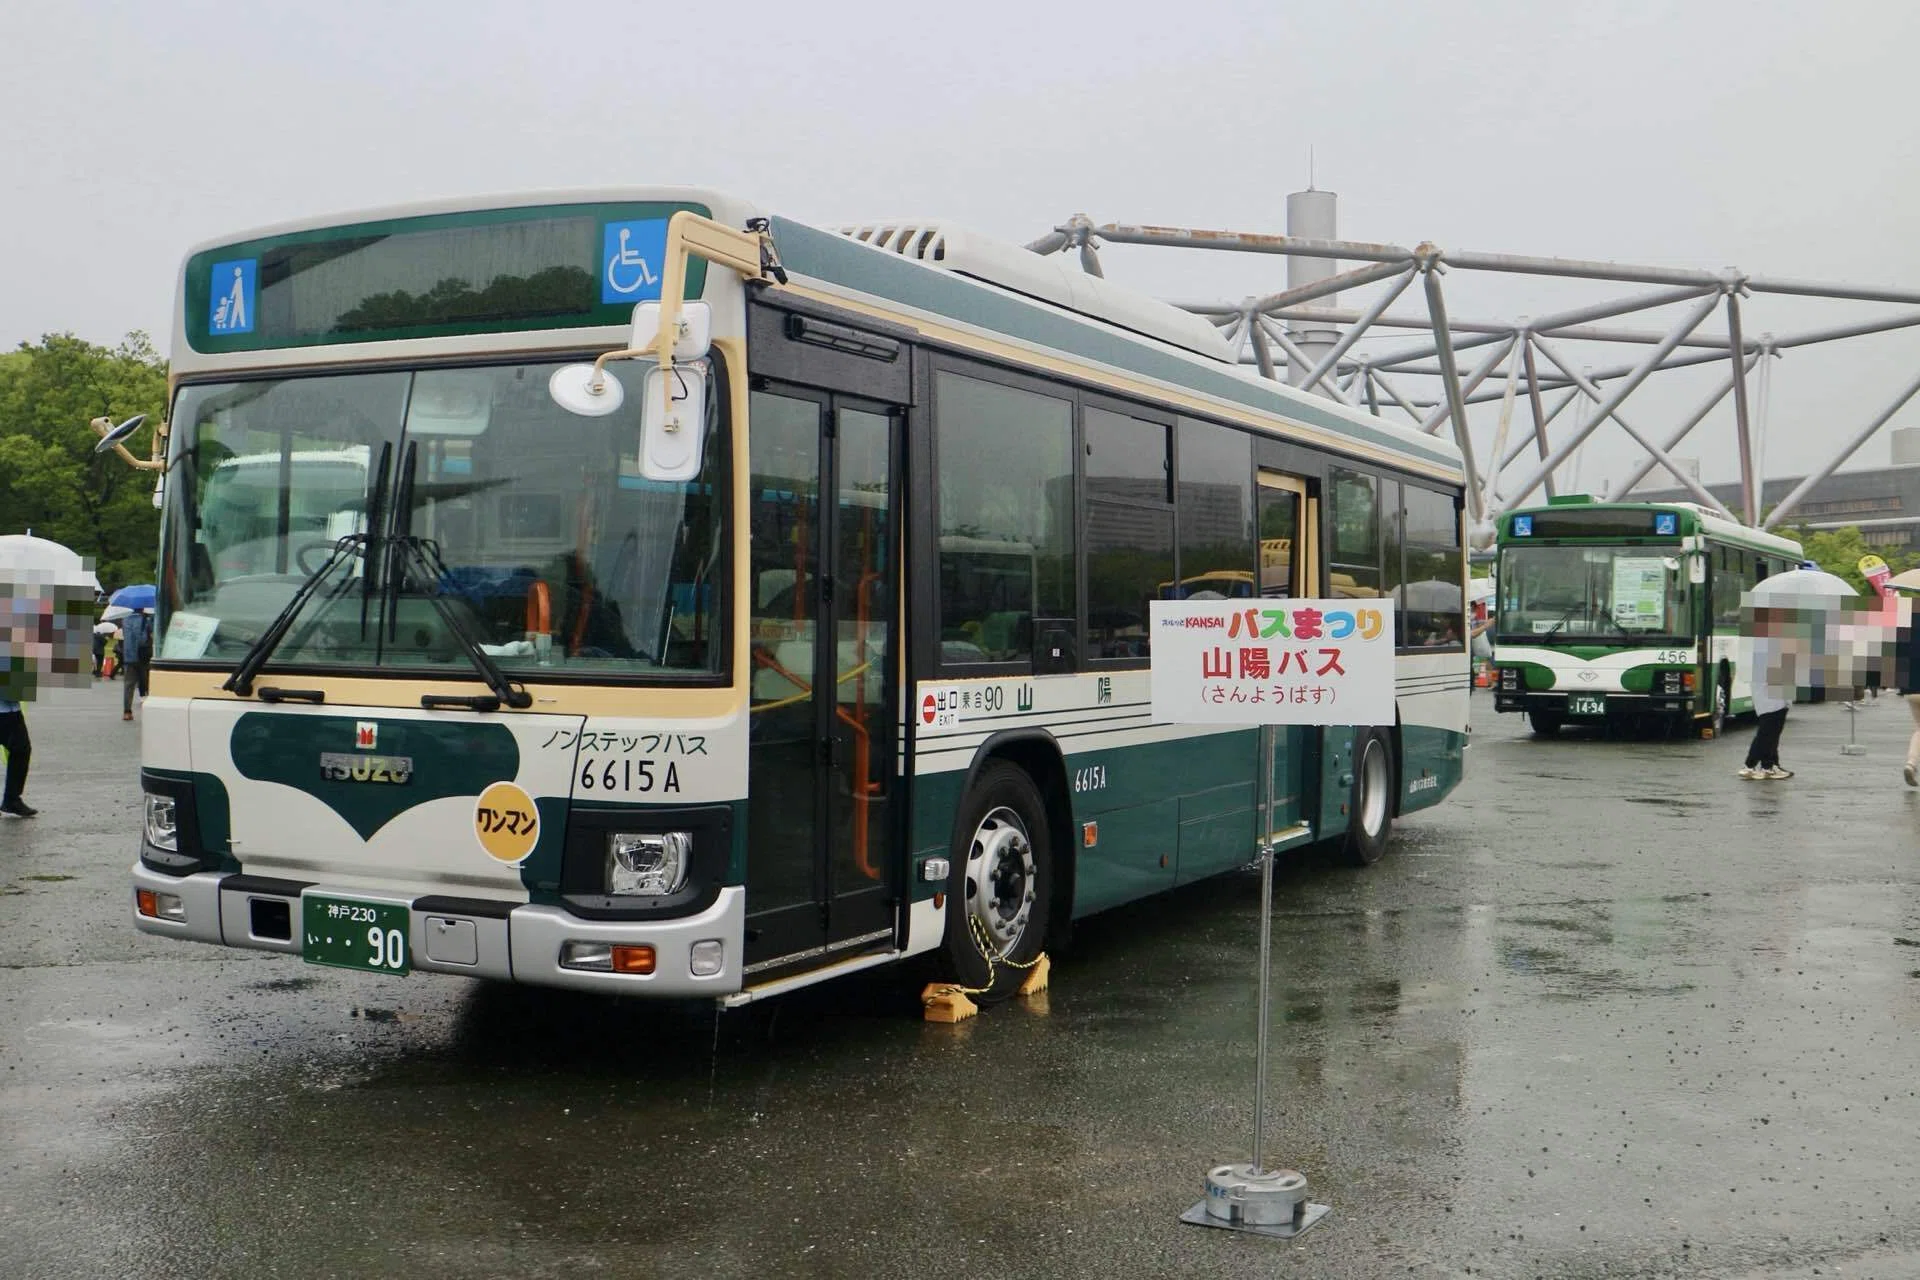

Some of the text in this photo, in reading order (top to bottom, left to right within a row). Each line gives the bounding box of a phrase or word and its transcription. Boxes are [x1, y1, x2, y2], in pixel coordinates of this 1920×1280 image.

[1228, 608, 1383, 640] バスまつり
[1202, 647, 1346, 679] 山陽バス
[1658, 651, 1687, 664] 456
[937, 691, 958, 711] 出口
[1201, 685, 1337, 705] （さんようばす）
[939, 714, 954, 725] EXIT
[542, 731, 708, 755] ノンステップバス
[581, 759, 681, 793] 6615A
[1075, 765, 1106, 793] 6615A
[478, 808, 536, 835] ワンマン
